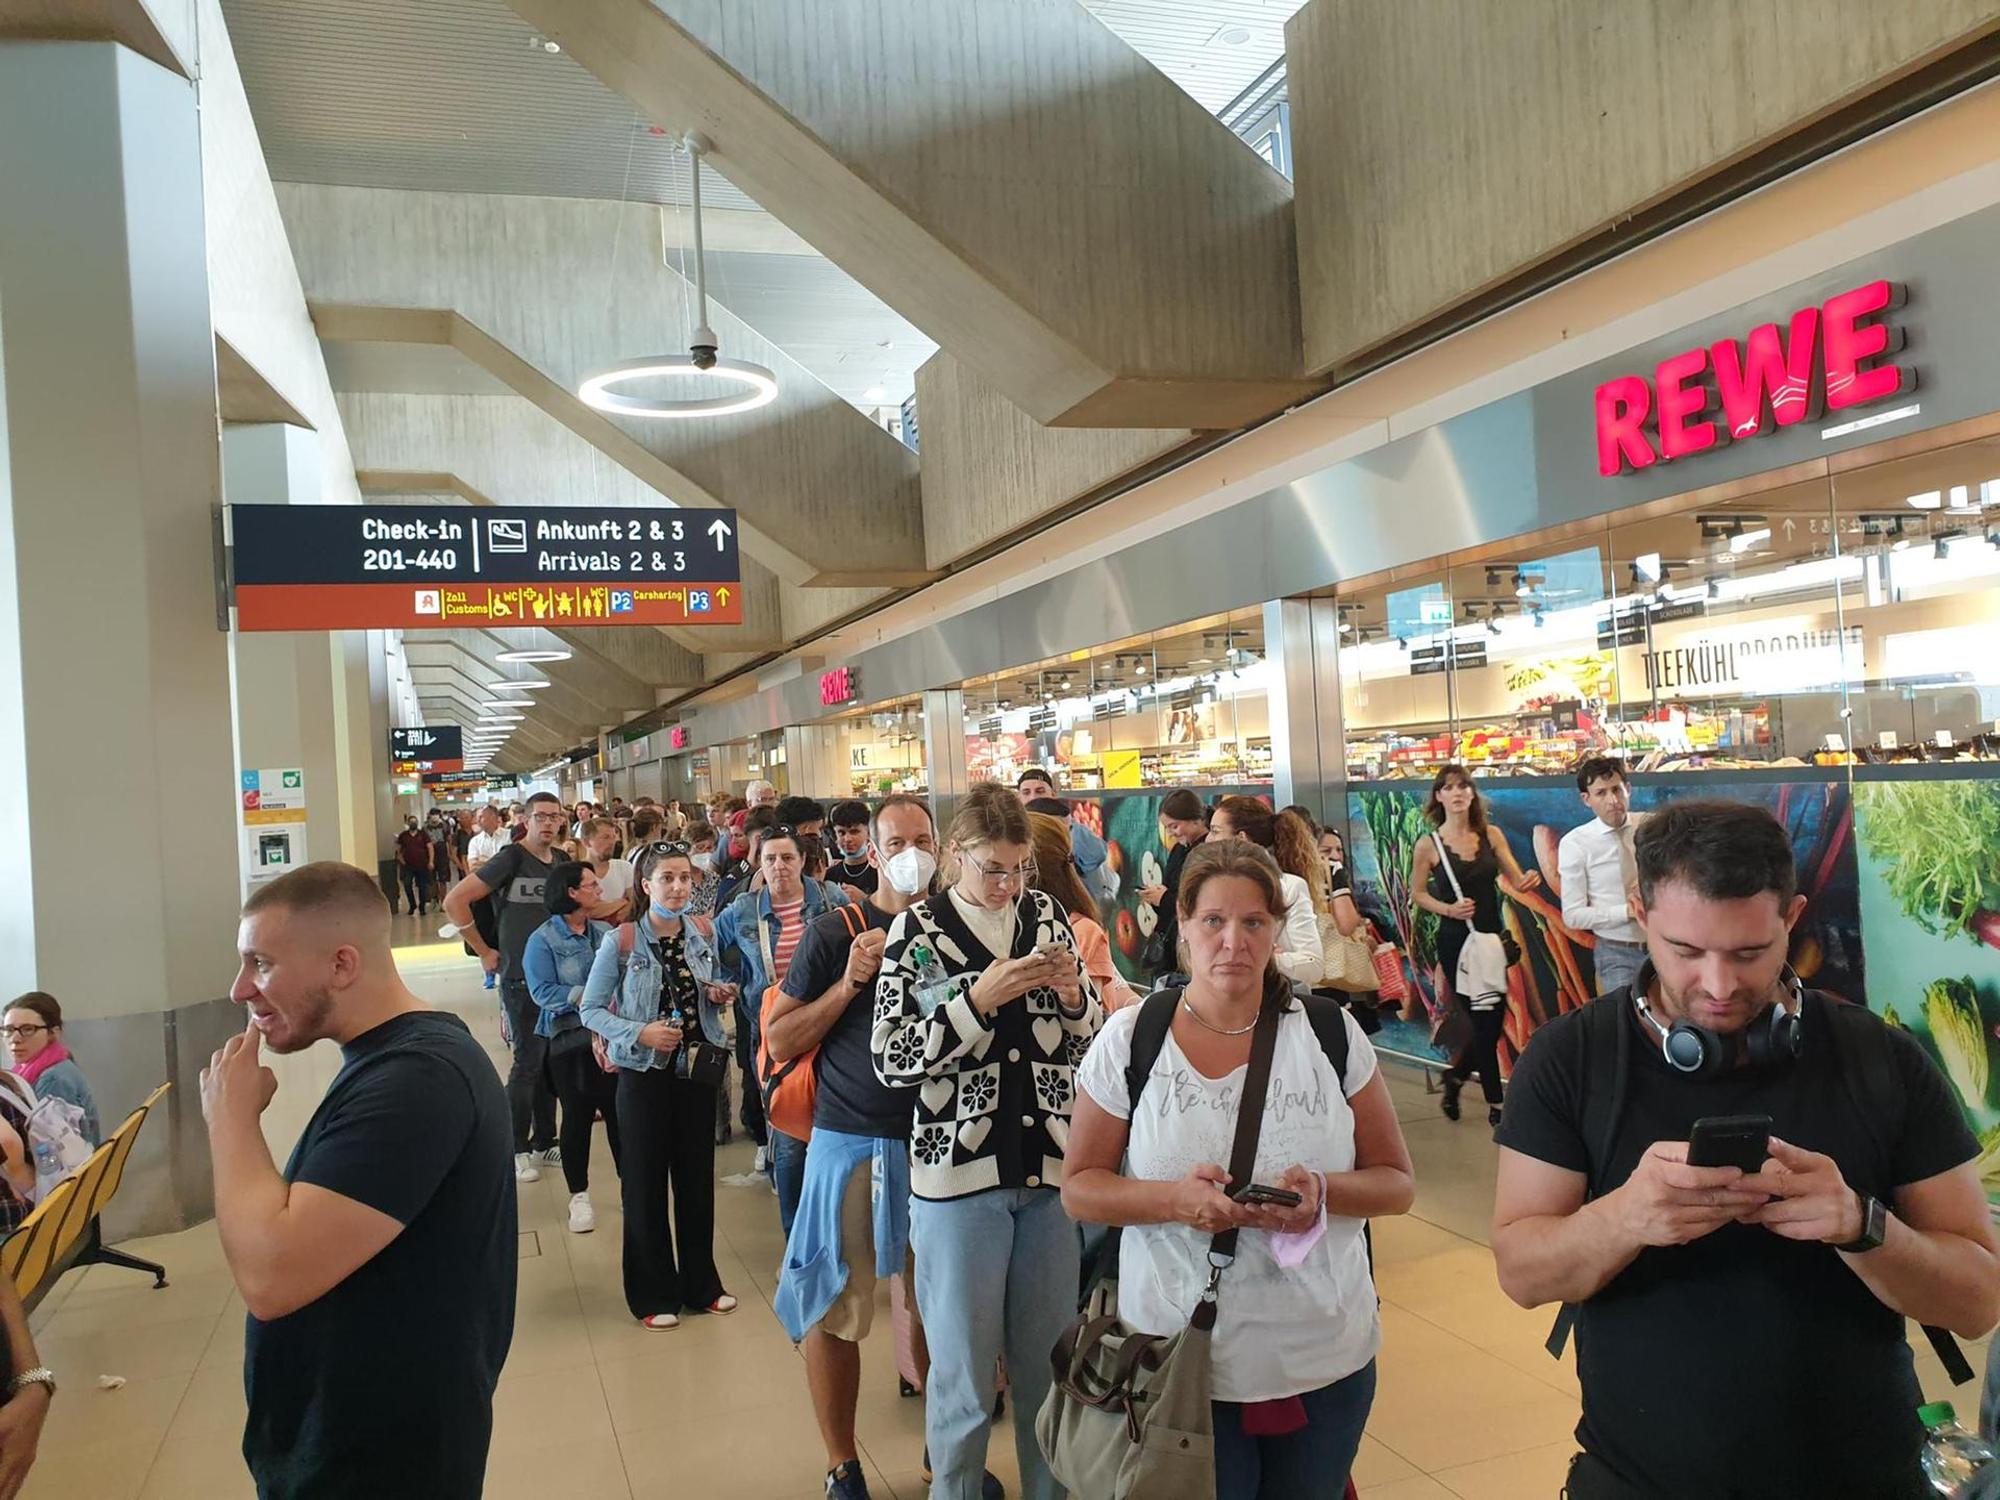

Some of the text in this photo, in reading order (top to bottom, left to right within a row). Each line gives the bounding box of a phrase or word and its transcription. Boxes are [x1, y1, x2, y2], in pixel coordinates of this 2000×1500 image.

[1594, 279, 1902, 477] REWE
[362, 518, 462, 540] Check-in
[536, 519, 685, 541] Ankunft 2 & 3
[363, 549, 457, 571] 201-440
[537, 550, 686, 572] Arrivals 2 & 3
[446, 592, 466, 603] Zoll
[503, 592, 518, 602] WC
[591, 587, 605, 597] WC
[633, 590, 682, 602] Carsharing
[446, 603, 489, 615] Customs
[820, 666, 851, 706] REWE
